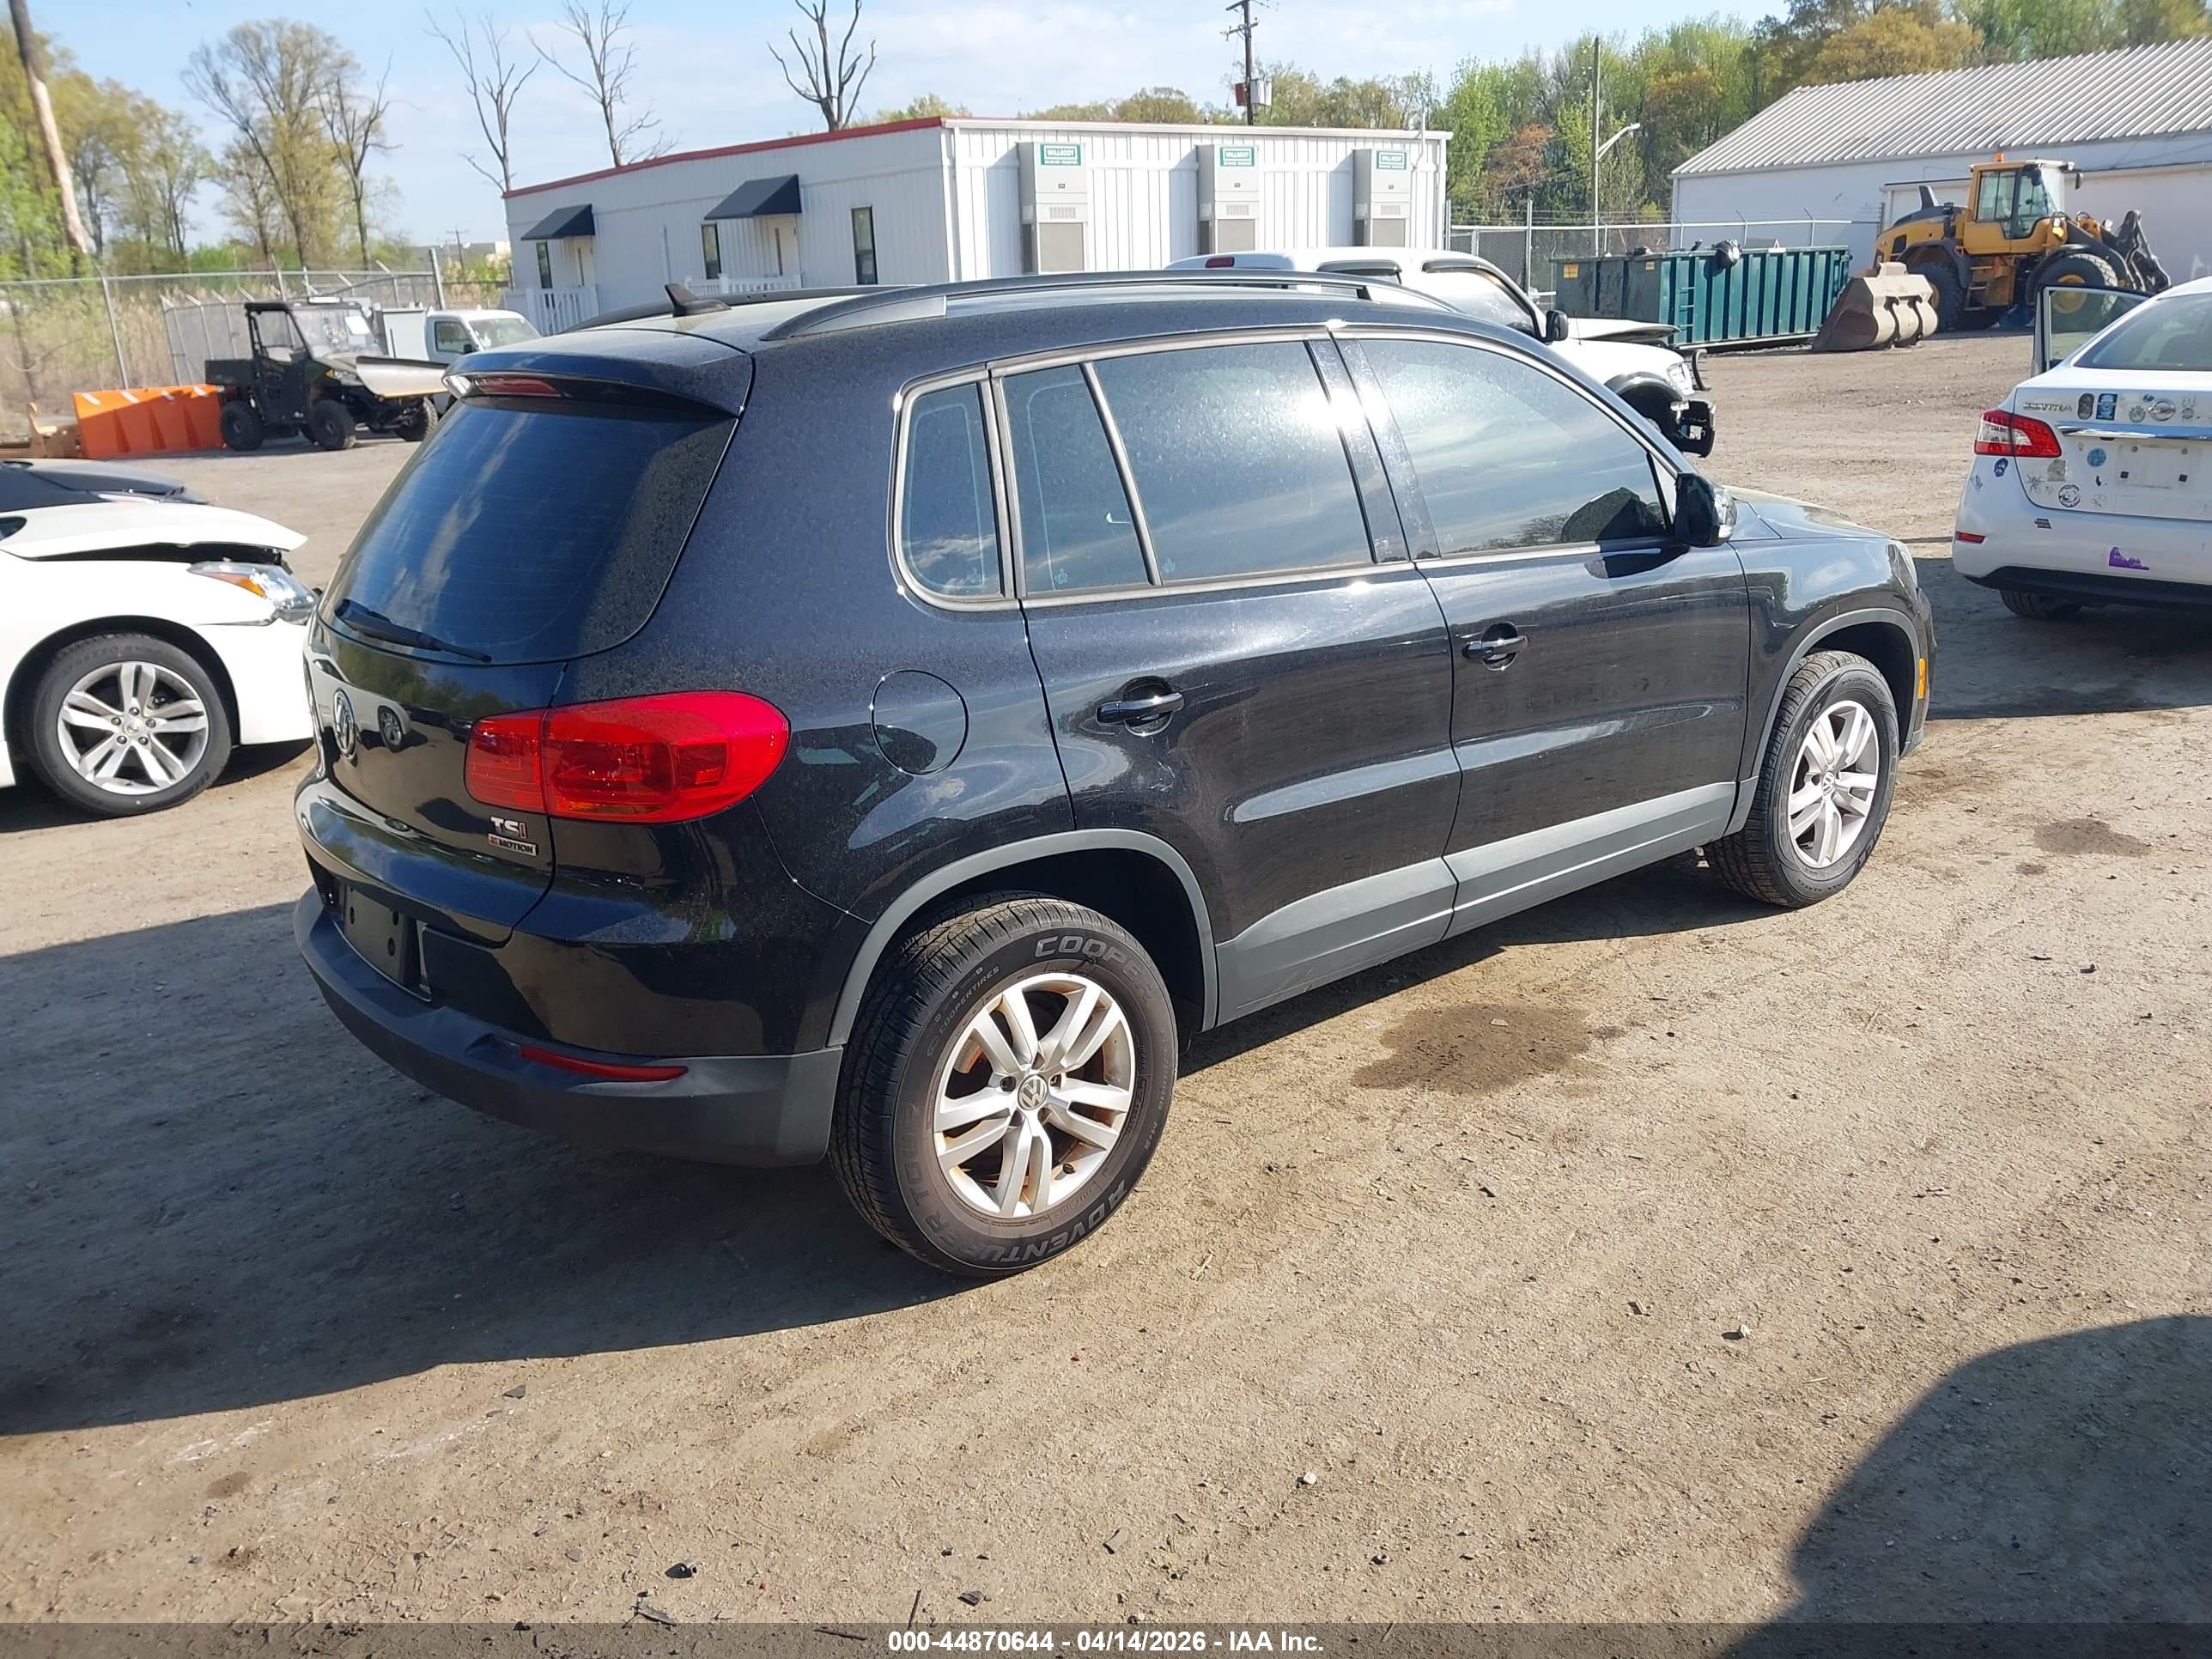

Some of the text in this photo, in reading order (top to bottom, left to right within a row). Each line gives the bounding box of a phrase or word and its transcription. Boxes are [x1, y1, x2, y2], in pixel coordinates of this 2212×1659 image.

[490, 817, 527, 839] TSI
[939, 965, 1000, 1034] COOPERTIRES
[1035, 935, 1155, 1006] COOPER
